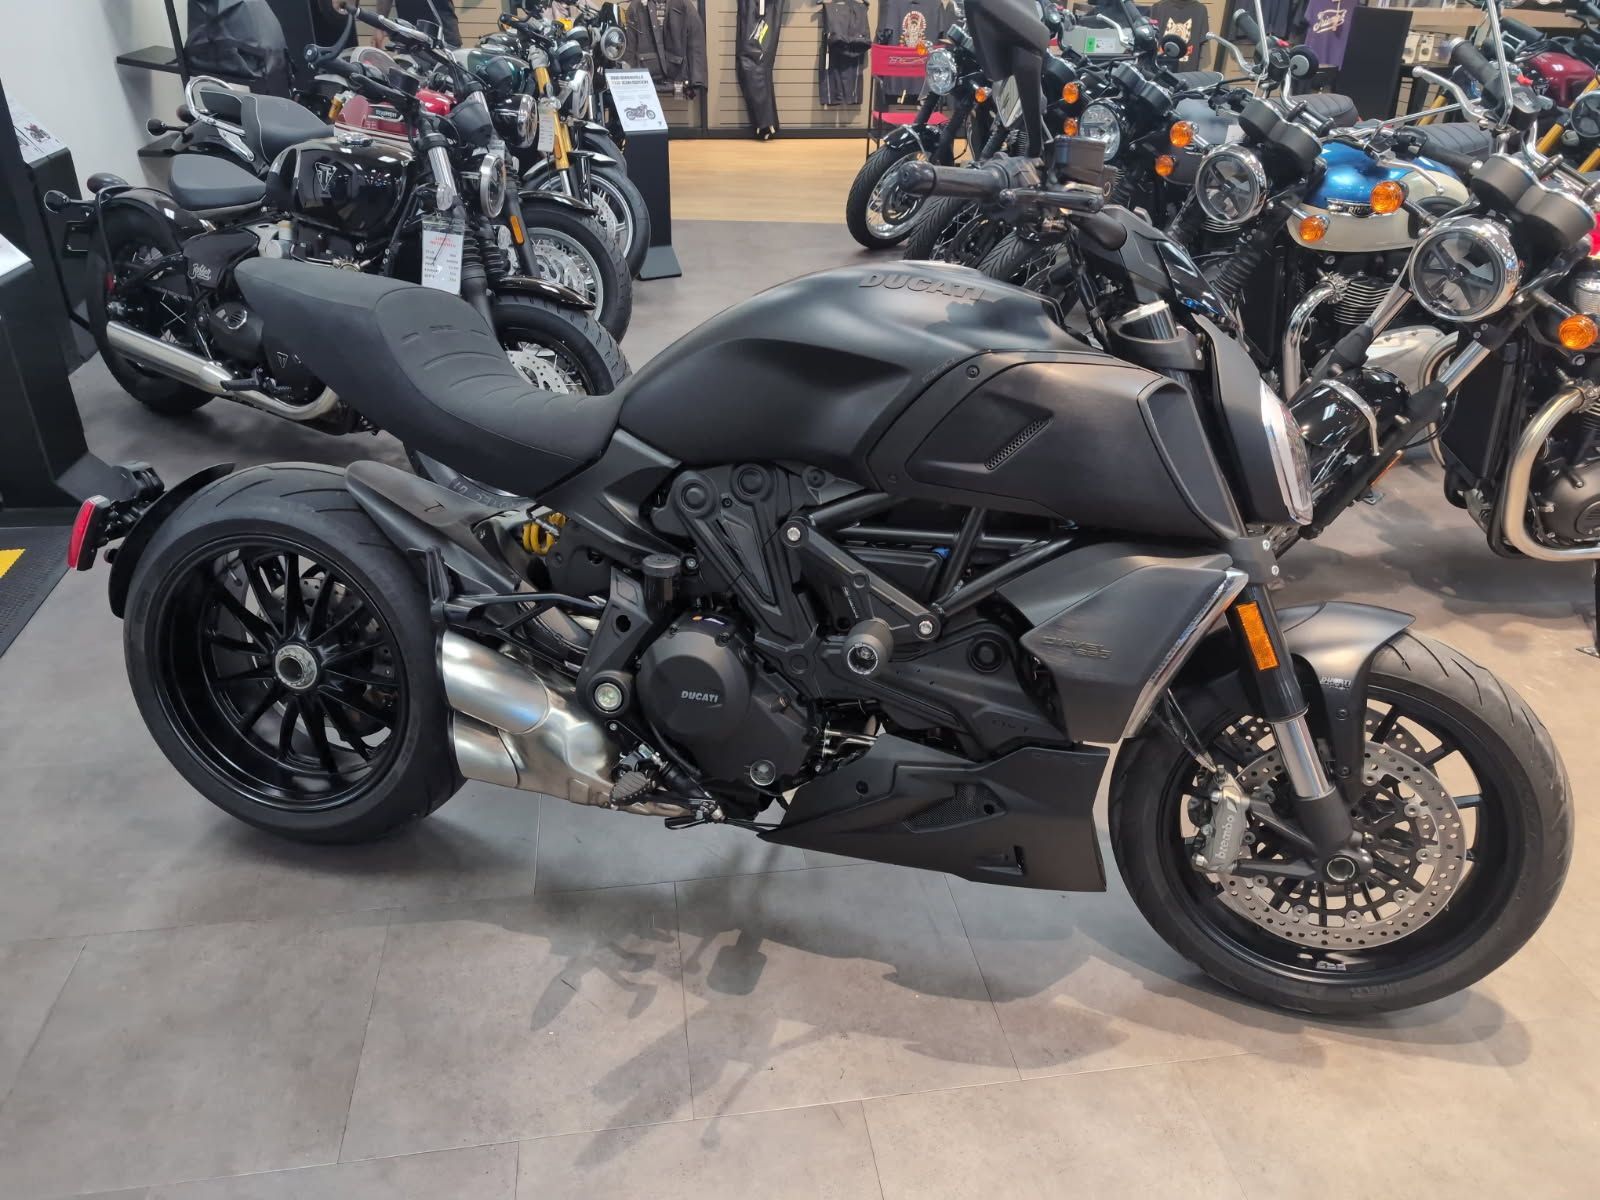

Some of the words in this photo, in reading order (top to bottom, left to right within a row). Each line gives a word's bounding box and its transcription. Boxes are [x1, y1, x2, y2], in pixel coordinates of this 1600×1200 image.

[857, 274, 985, 301] DUCATI
[681, 690, 718, 703] DUCATI
[1215, 814, 1234, 859] brembo
